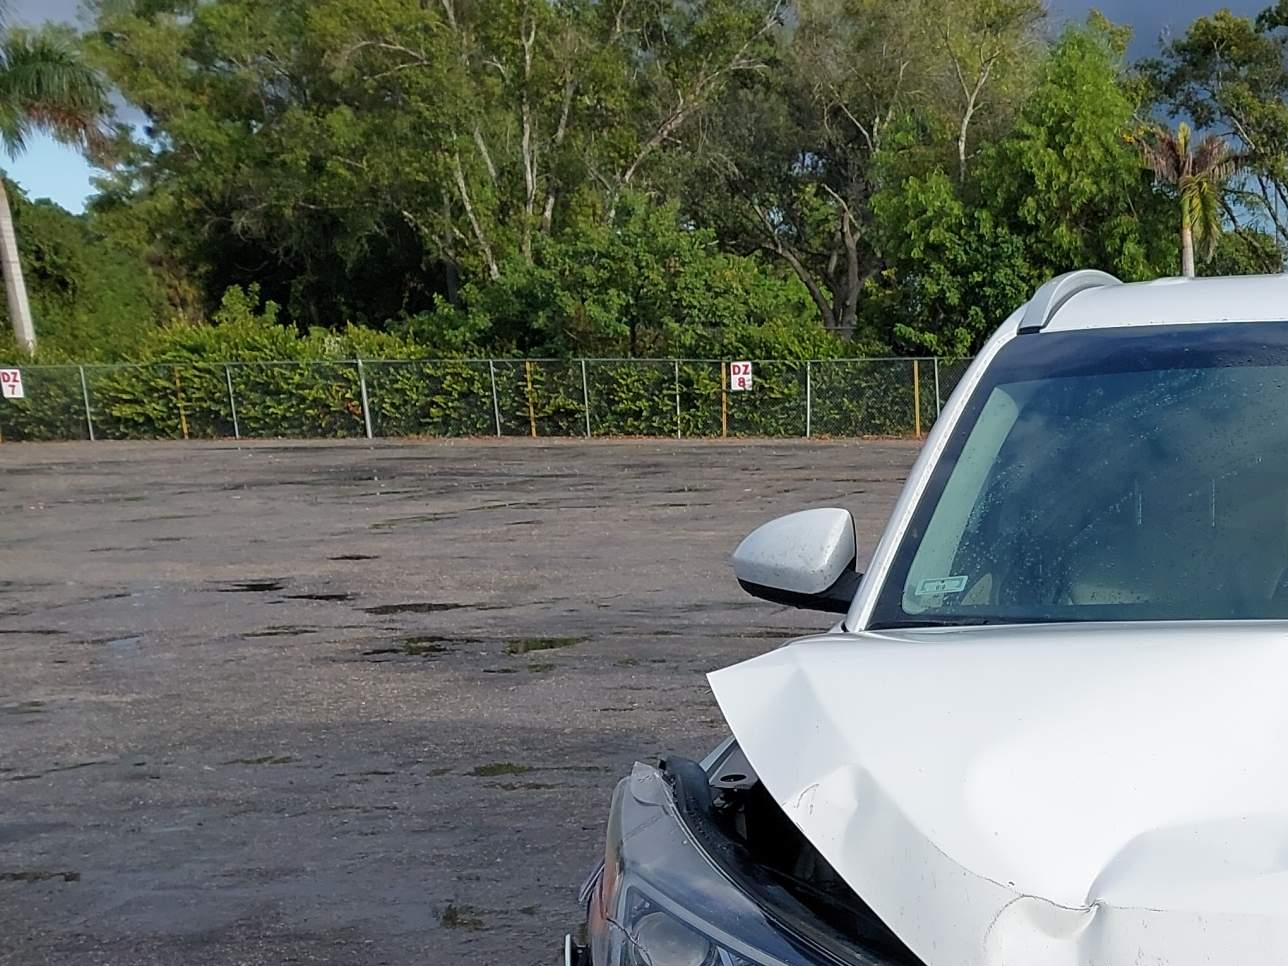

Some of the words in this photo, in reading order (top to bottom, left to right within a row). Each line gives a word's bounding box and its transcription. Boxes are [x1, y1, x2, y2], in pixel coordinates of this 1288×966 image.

[732, 364, 750, 375] DZ
[1, 371, 20, 383] DZ
[737, 377, 746, 388] 8
[8, 384, 16, 395] 7
